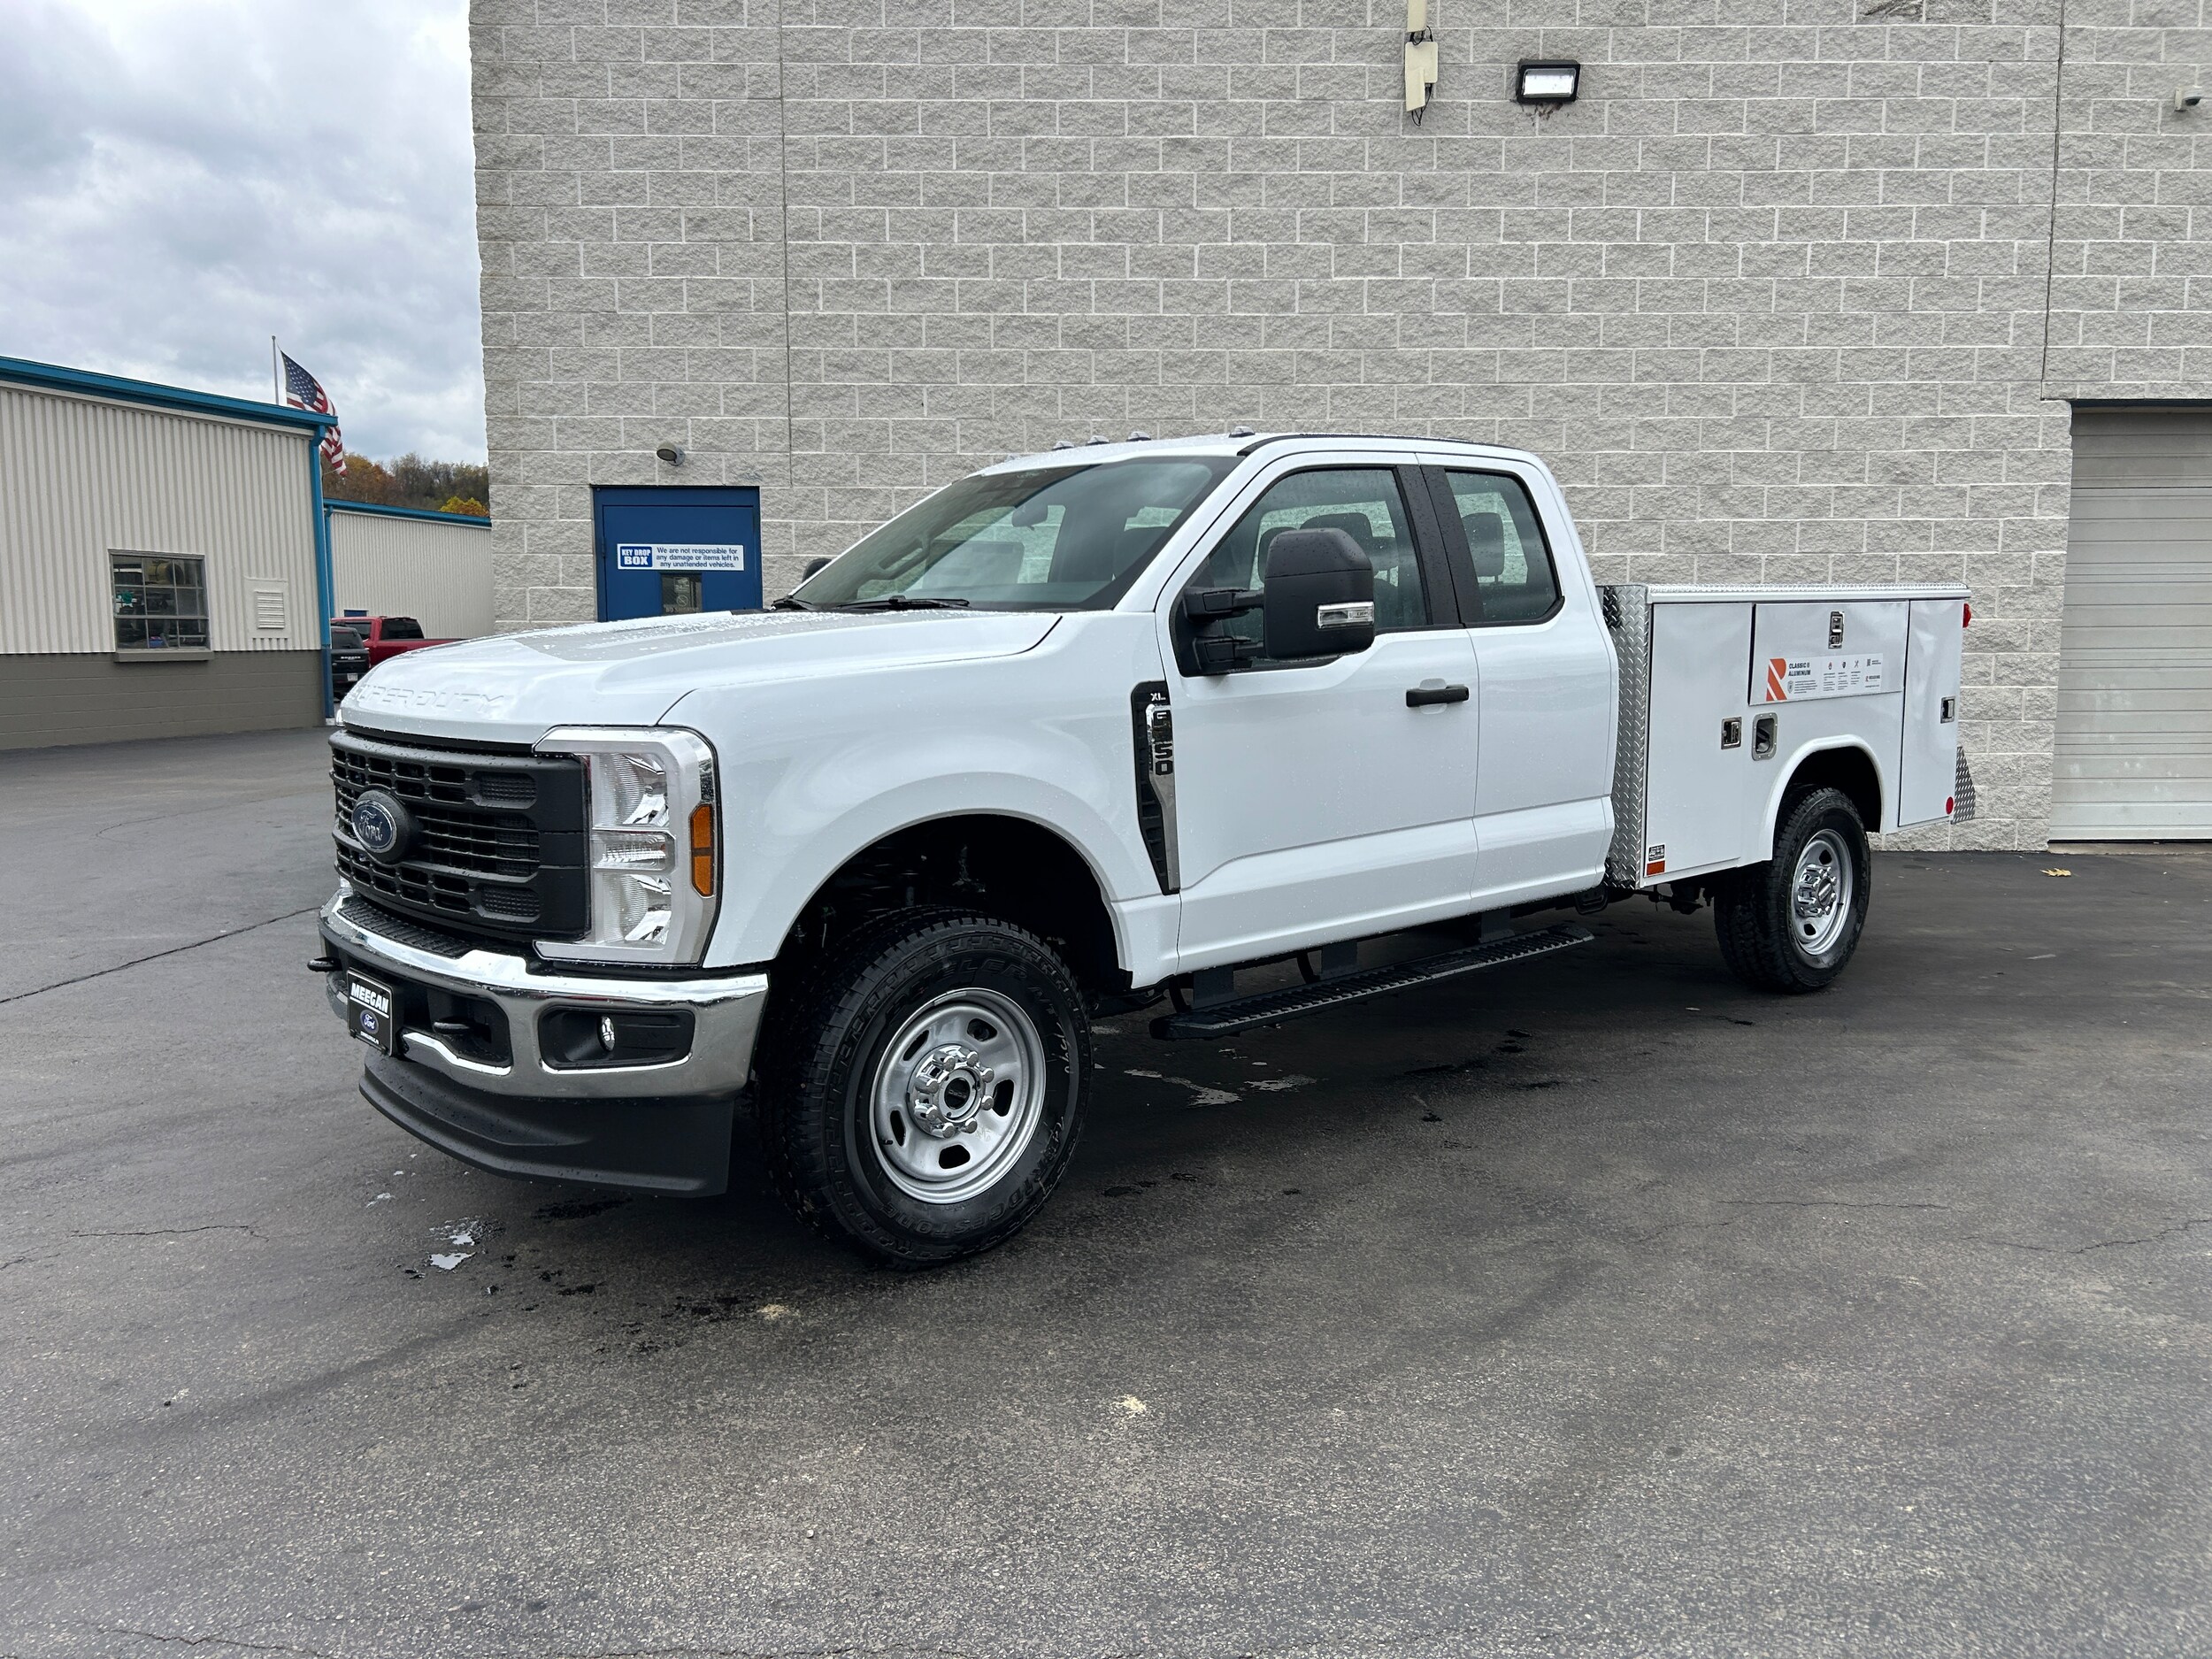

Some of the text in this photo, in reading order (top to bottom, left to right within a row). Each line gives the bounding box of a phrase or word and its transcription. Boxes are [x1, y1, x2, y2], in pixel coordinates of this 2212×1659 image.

[692, 547, 727, 556] responsible
[624, 557, 649, 565] BOX
[1150, 693, 1166, 702] XL
[358, 810, 383, 841] Ford
[350, 982, 389, 1013] MEEGAN
